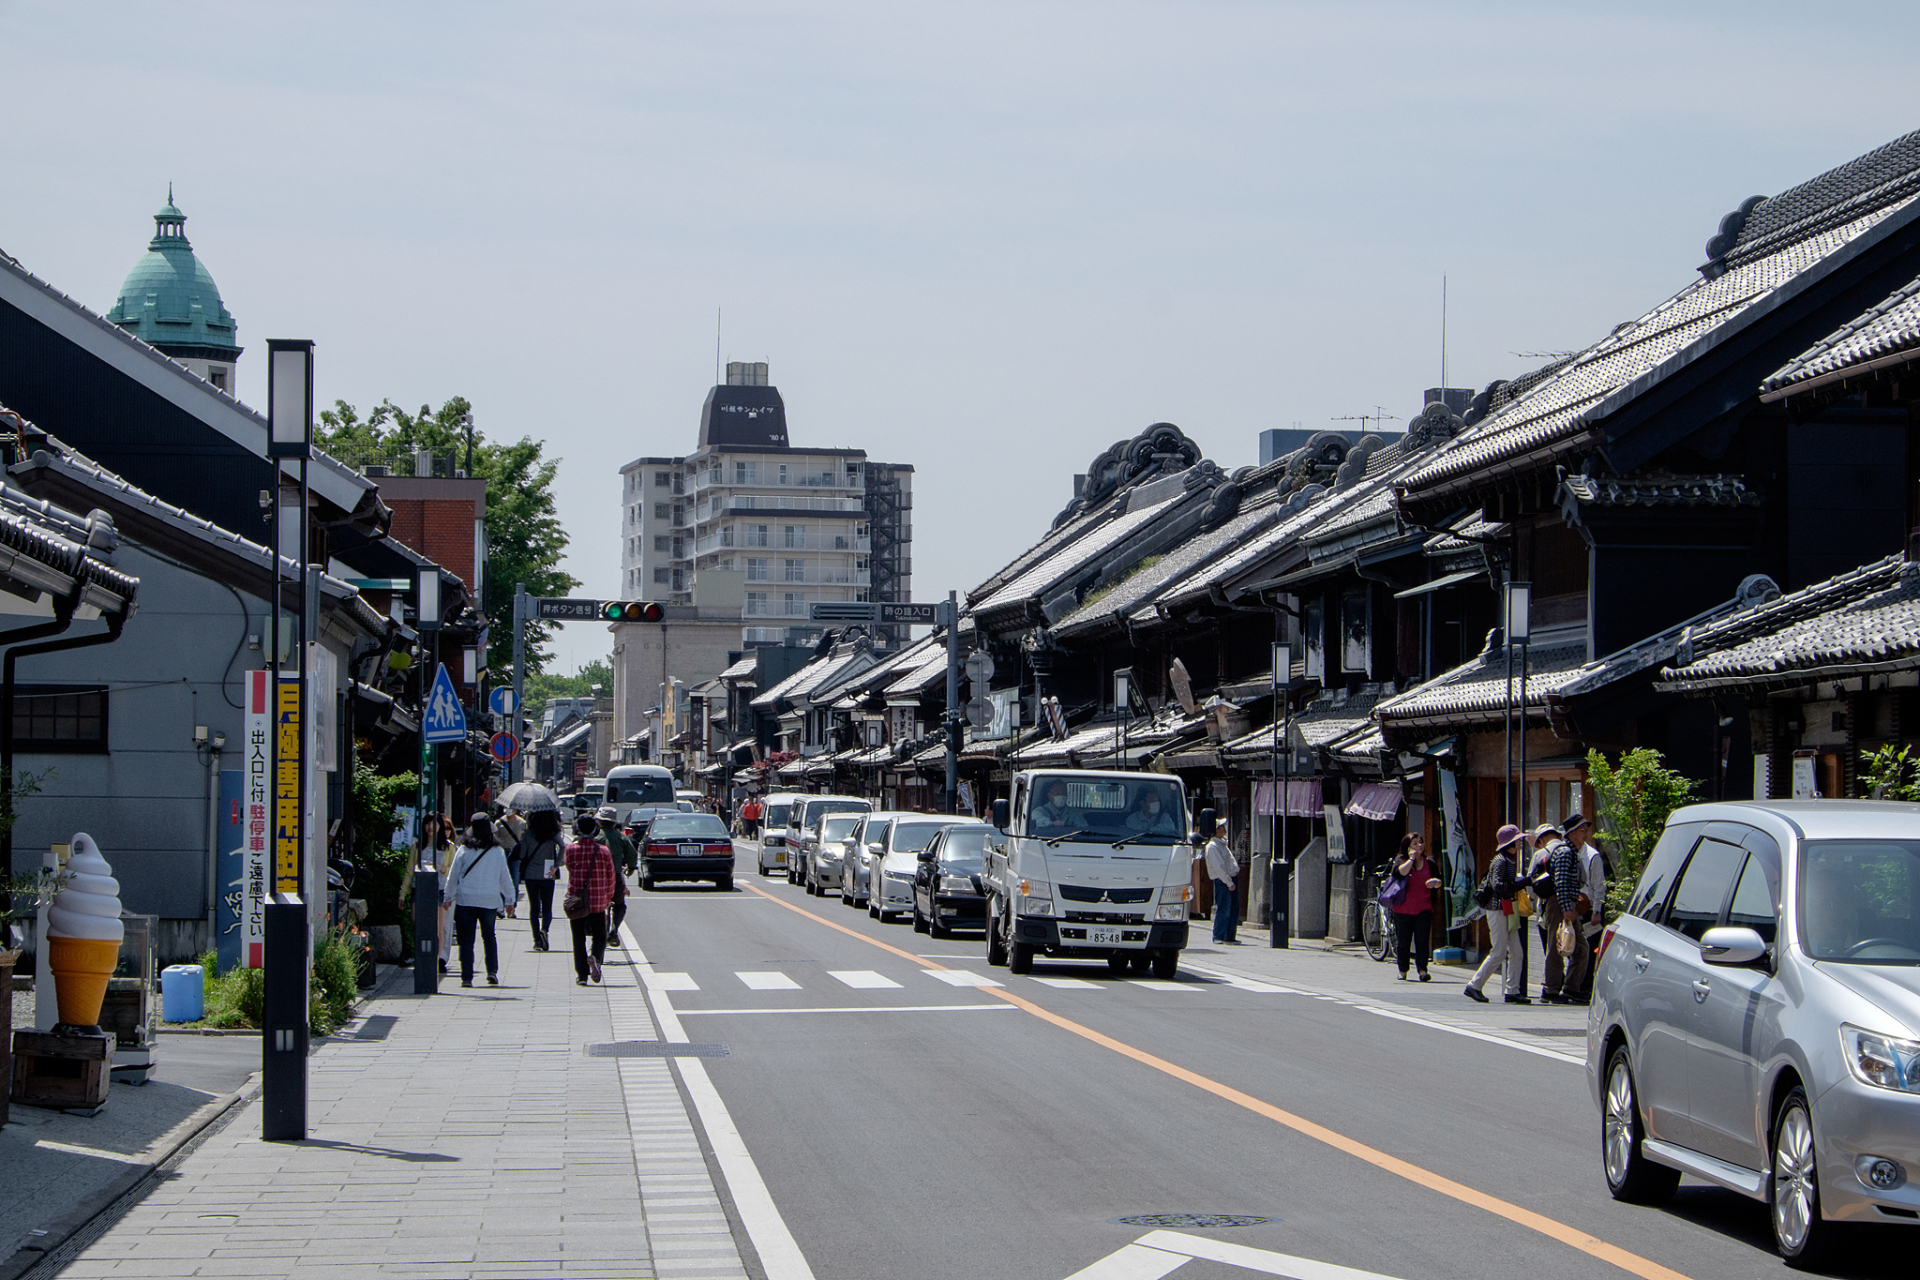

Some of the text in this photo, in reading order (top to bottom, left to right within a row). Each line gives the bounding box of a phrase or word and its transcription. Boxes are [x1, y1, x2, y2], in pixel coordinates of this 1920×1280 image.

[543, 604, 592, 615] 押ボタン信号
[884, 606, 931, 616] 時の鐘入口
[1094, 933, 1120, 943] 85-48
